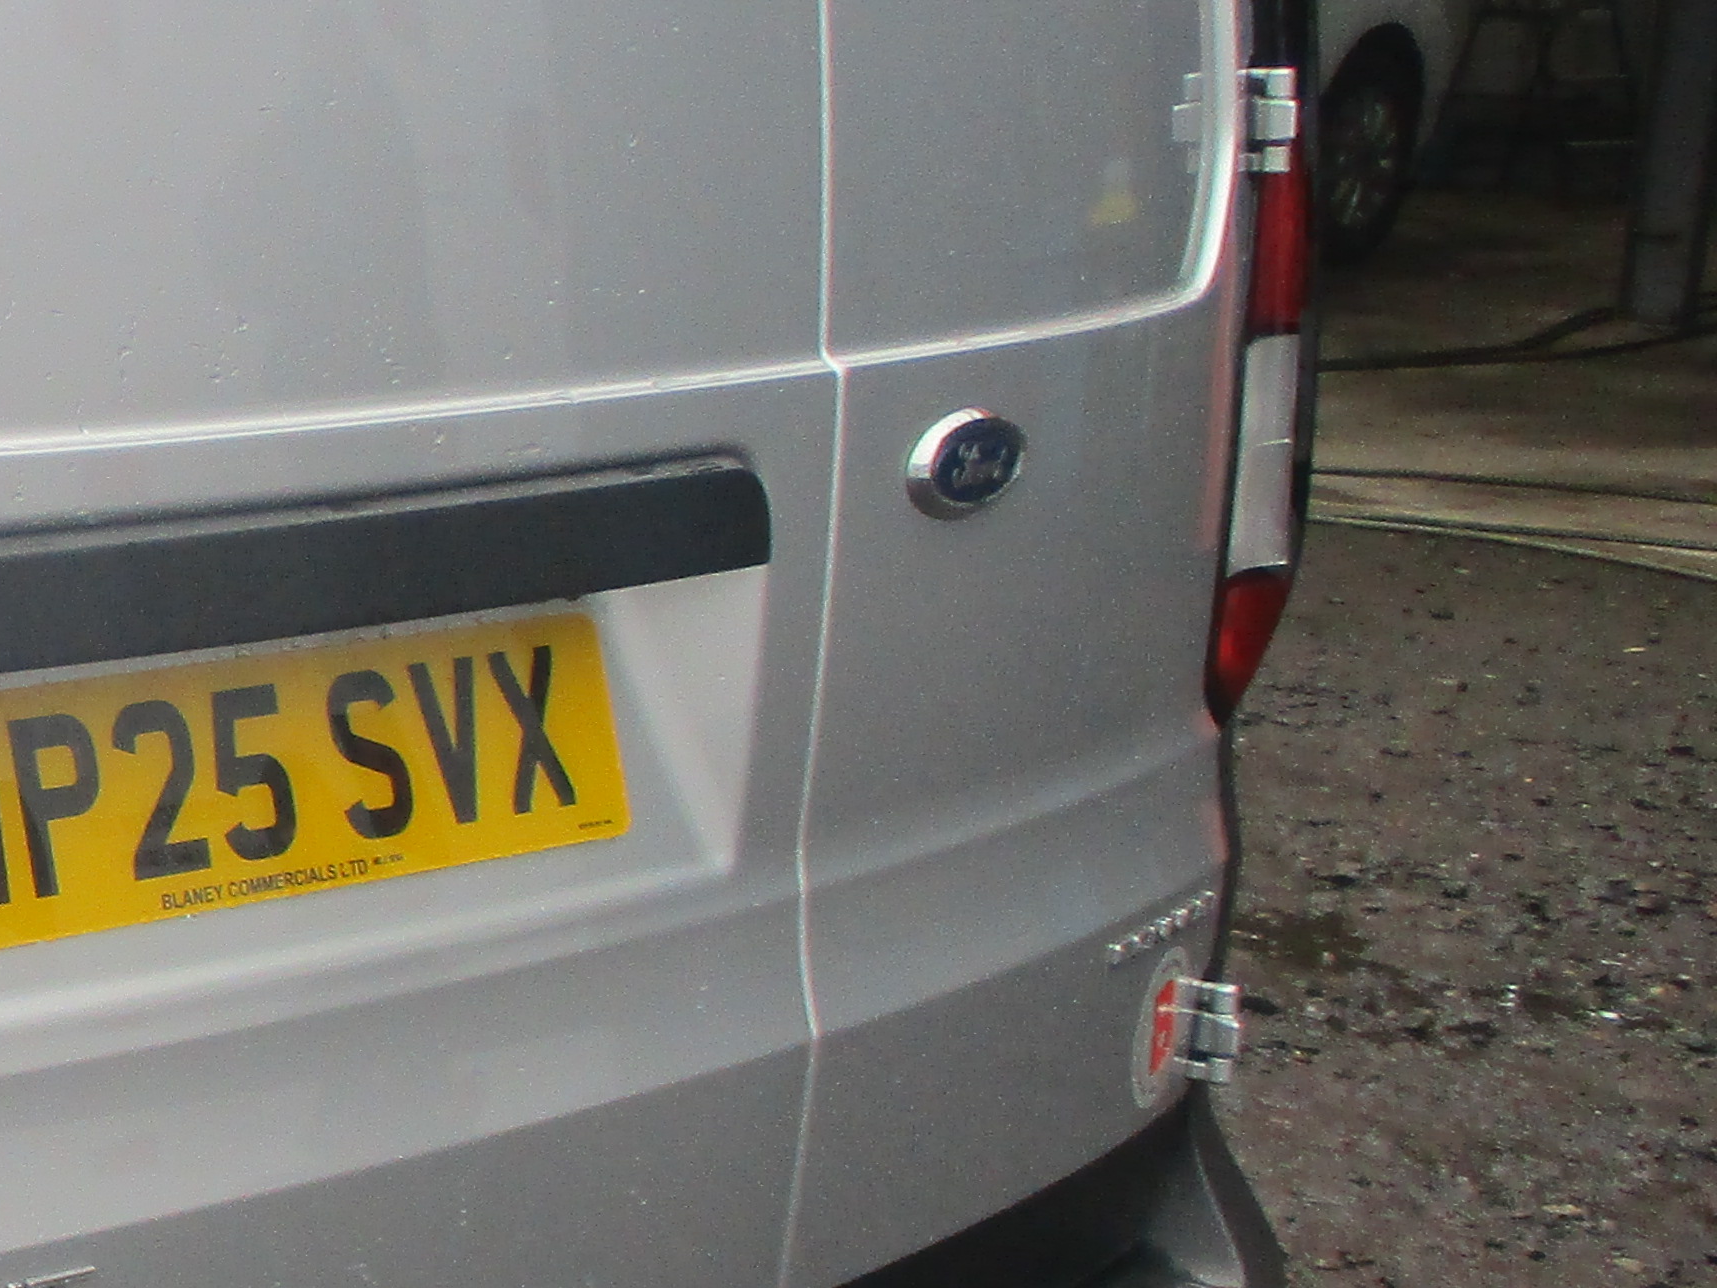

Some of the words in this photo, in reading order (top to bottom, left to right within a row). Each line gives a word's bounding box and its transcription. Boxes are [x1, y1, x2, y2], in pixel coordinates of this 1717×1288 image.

[326, 644, 577, 839] SVX
[161, 884, 224, 911] BLANEY
[227, 863, 337, 898] COMMERCIALS
